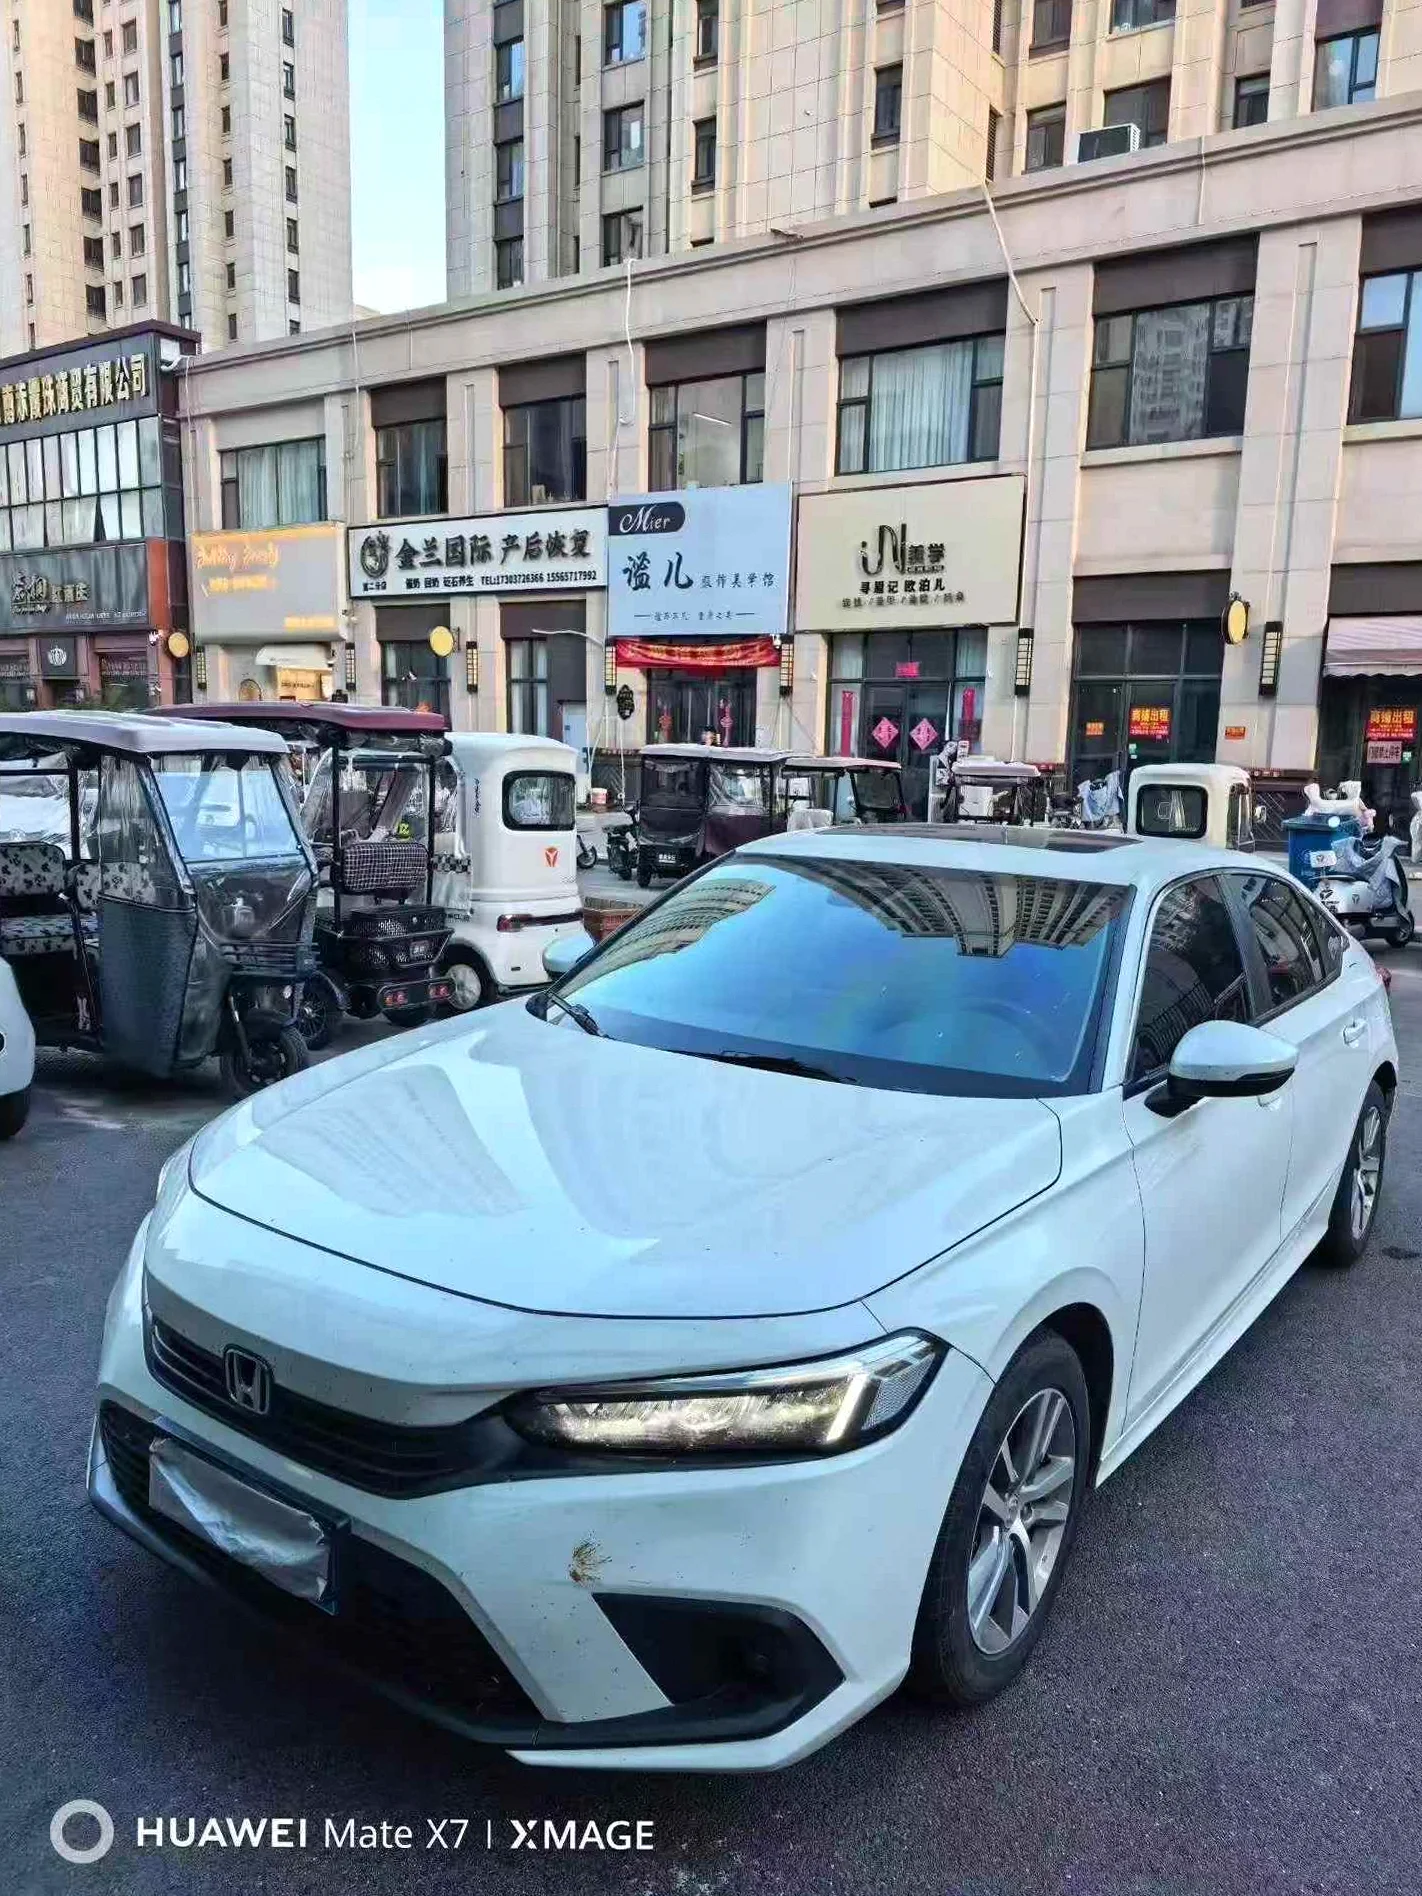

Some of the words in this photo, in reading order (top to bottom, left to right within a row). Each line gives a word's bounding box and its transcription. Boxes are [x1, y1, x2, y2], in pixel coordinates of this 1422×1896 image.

[619, 505, 671, 534] Mier
[395, 534, 493, 570] 金兰国际
[500, 528, 591, 564] 产后恢复
